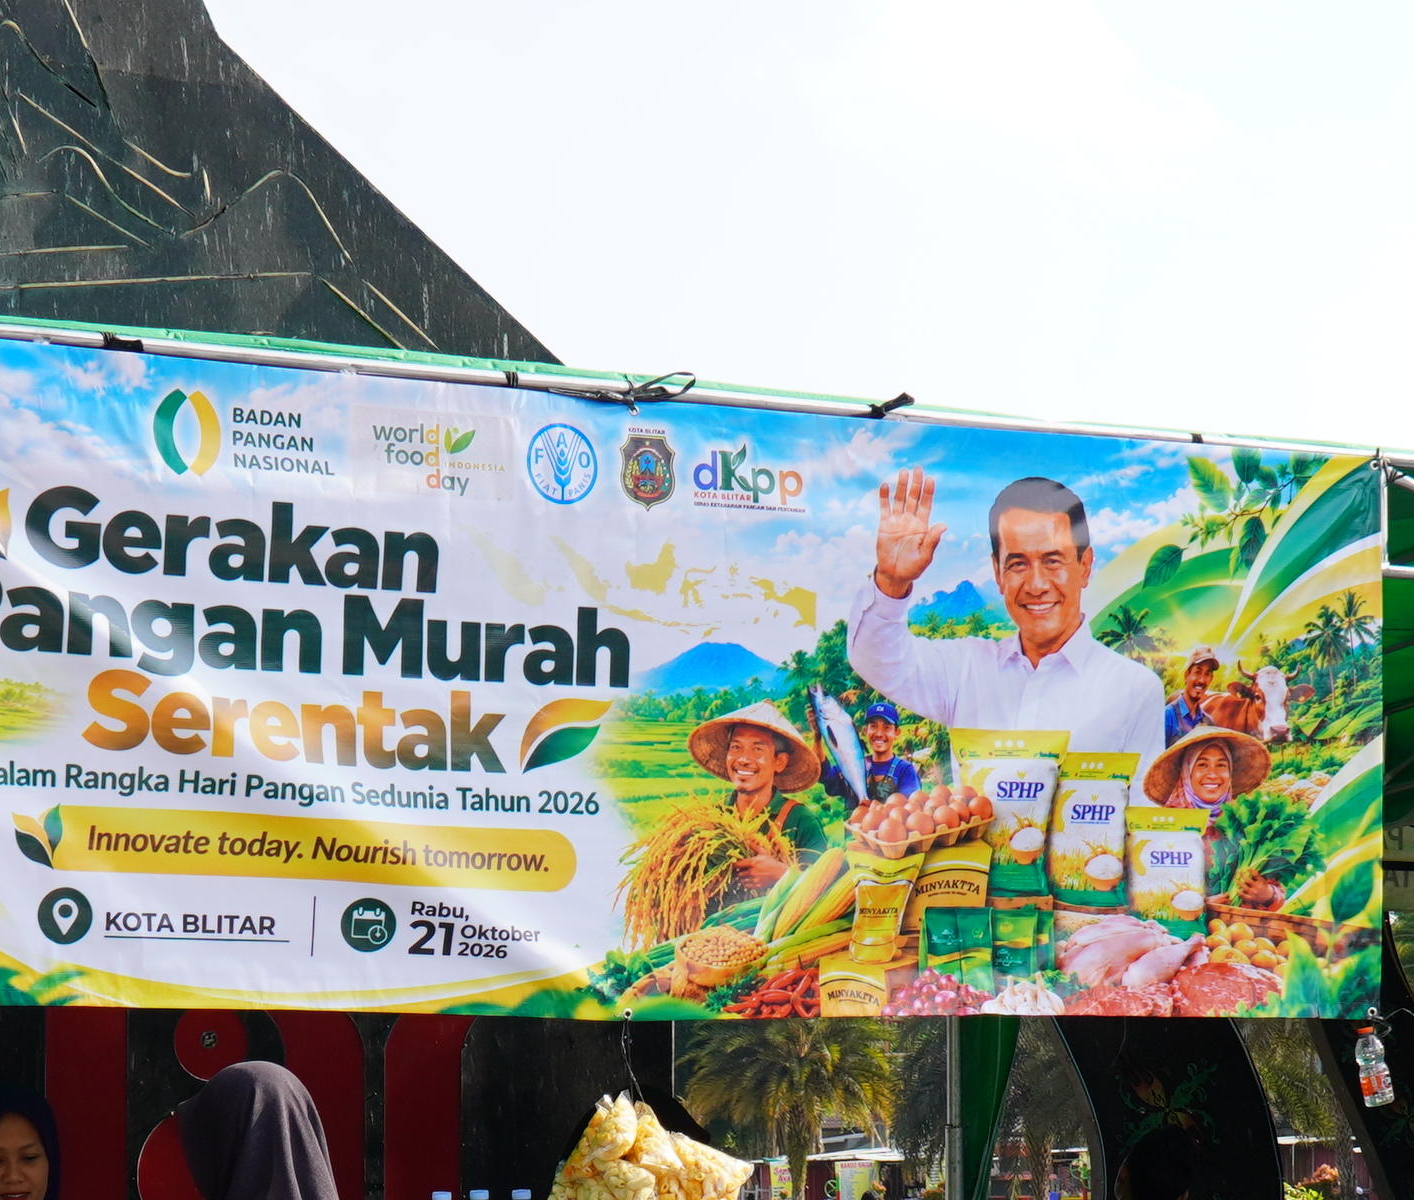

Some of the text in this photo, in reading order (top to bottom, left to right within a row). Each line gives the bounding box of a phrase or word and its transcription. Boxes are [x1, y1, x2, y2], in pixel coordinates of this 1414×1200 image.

[232, 406, 303, 429] BADAN
[232, 429, 315, 453] PANGAN
[372, 423, 440, 445] world
[233, 453, 336, 476] NASIONAL
[384, 442, 440, 468] food
[443, 460, 506, 472] INDONESIA
[426, 469, 470, 497] day
[535, 472, 592, 497] FIAT PANIS
[694, 491, 752, 502] KOTA BLITAR
[24, 485, 440, 594] Gerakan
[342, 594, 632, 688] Murah
[81, 669, 507, 774] Serentak
[65, 766, 170, 798] Rangka
[177, 769, 237, 797] Hari
[244, 775, 345, 809] Pangan
[351, 780, 450, 812] Sedunia
[456, 787, 532, 814] Tahun
[538, 790, 600, 816] 2026
[996, 781, 1044, 799] SPHP
[1070, 804, 1116, 821] SPHP
[87, 826, 550, 874] Innovate today. Nourish tomorrow.
[1149, 851, 1193, 866] SPHP
[104, 911, 276, 936] KOTA BLITAR
[410, 900, 470, 924] Rabu,
[407, 921, 541, 957] 21 Oktober
[458, 940, 508, 960] 2026
